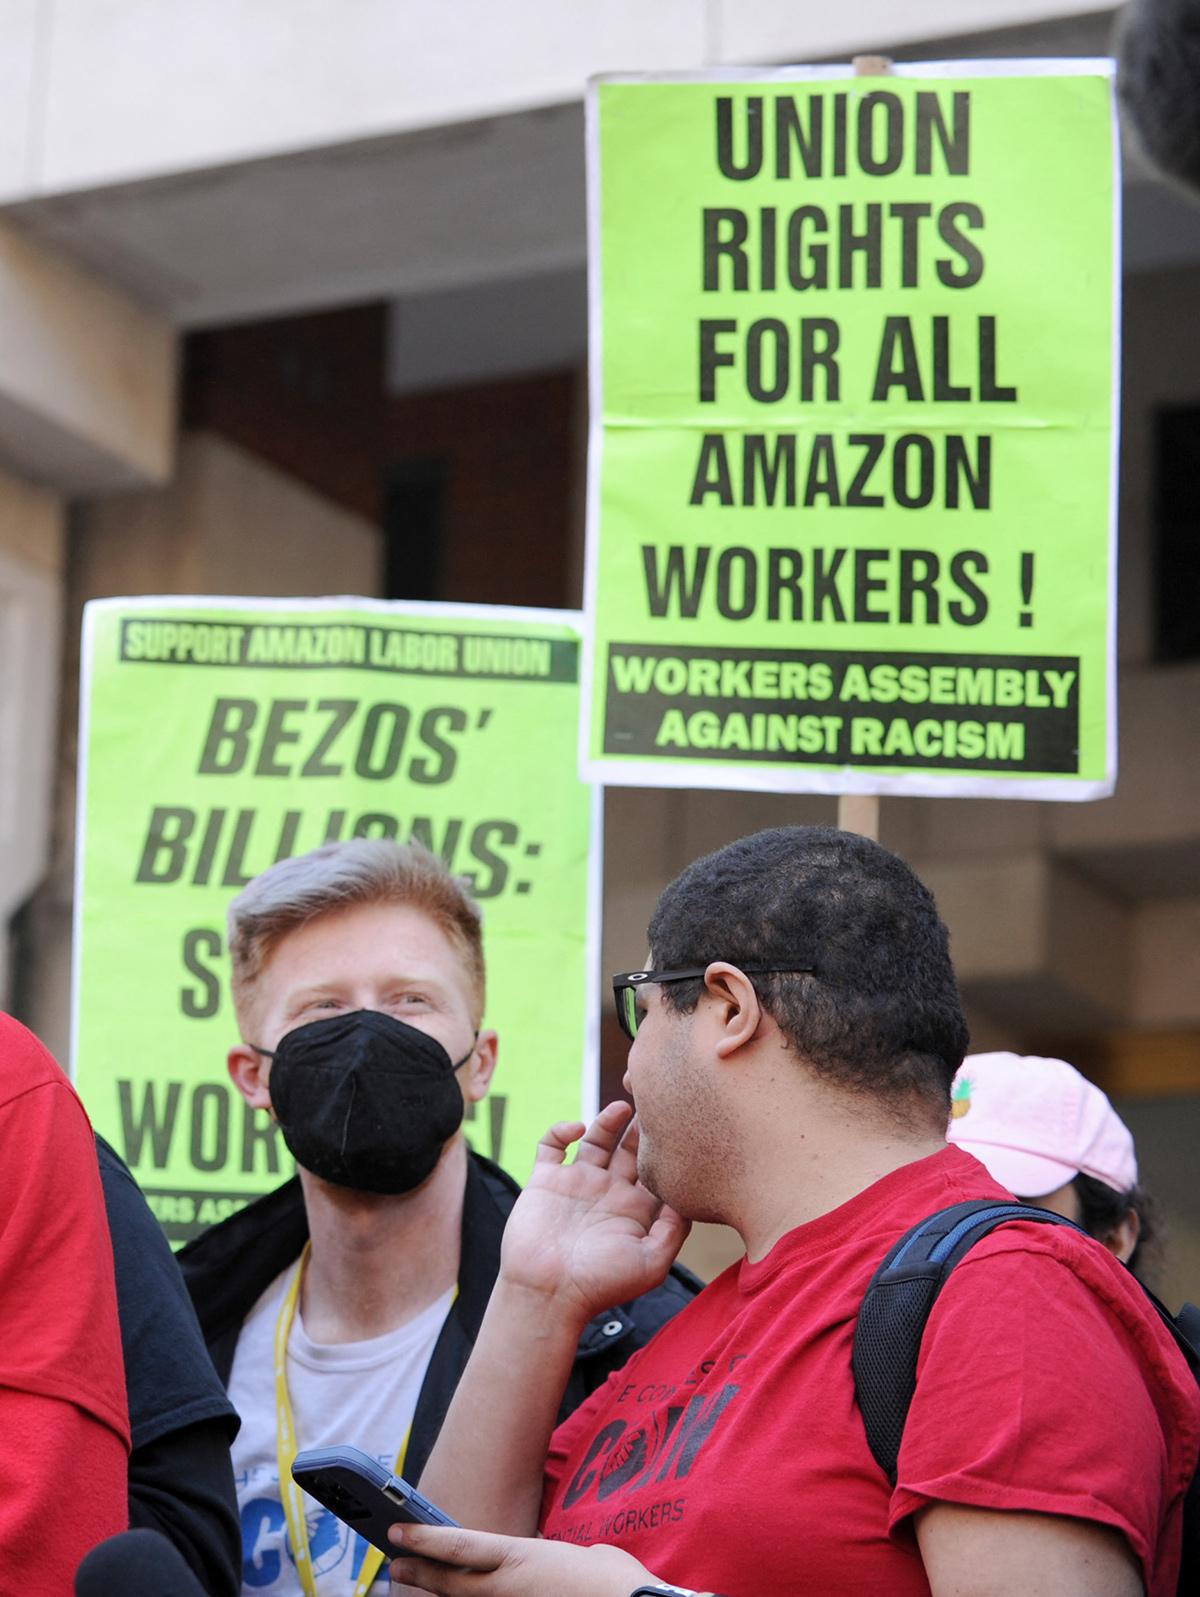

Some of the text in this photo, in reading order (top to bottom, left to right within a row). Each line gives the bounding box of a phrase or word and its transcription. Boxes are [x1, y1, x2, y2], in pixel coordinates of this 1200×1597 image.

[715, 91, 972, 180] UNION
[702, 200, 985, 293] RIGHTS
[698, 314, 1017, 404] FOR ALL
[689, 432, 992, 511] AMAZON
[641, 545, 990, 628] WORKERS
[125, 623, 551, 677] SUPPORT AMAZON LABOR UNION
[611, 655, 1076, 708] WORKERS ASSEMBLY
[197, 697, 494, 785] BEZOS'
[655, 708, 1025, 761] AGAINST RACISM
[598, 1498, 686, 1537] WORKERS
